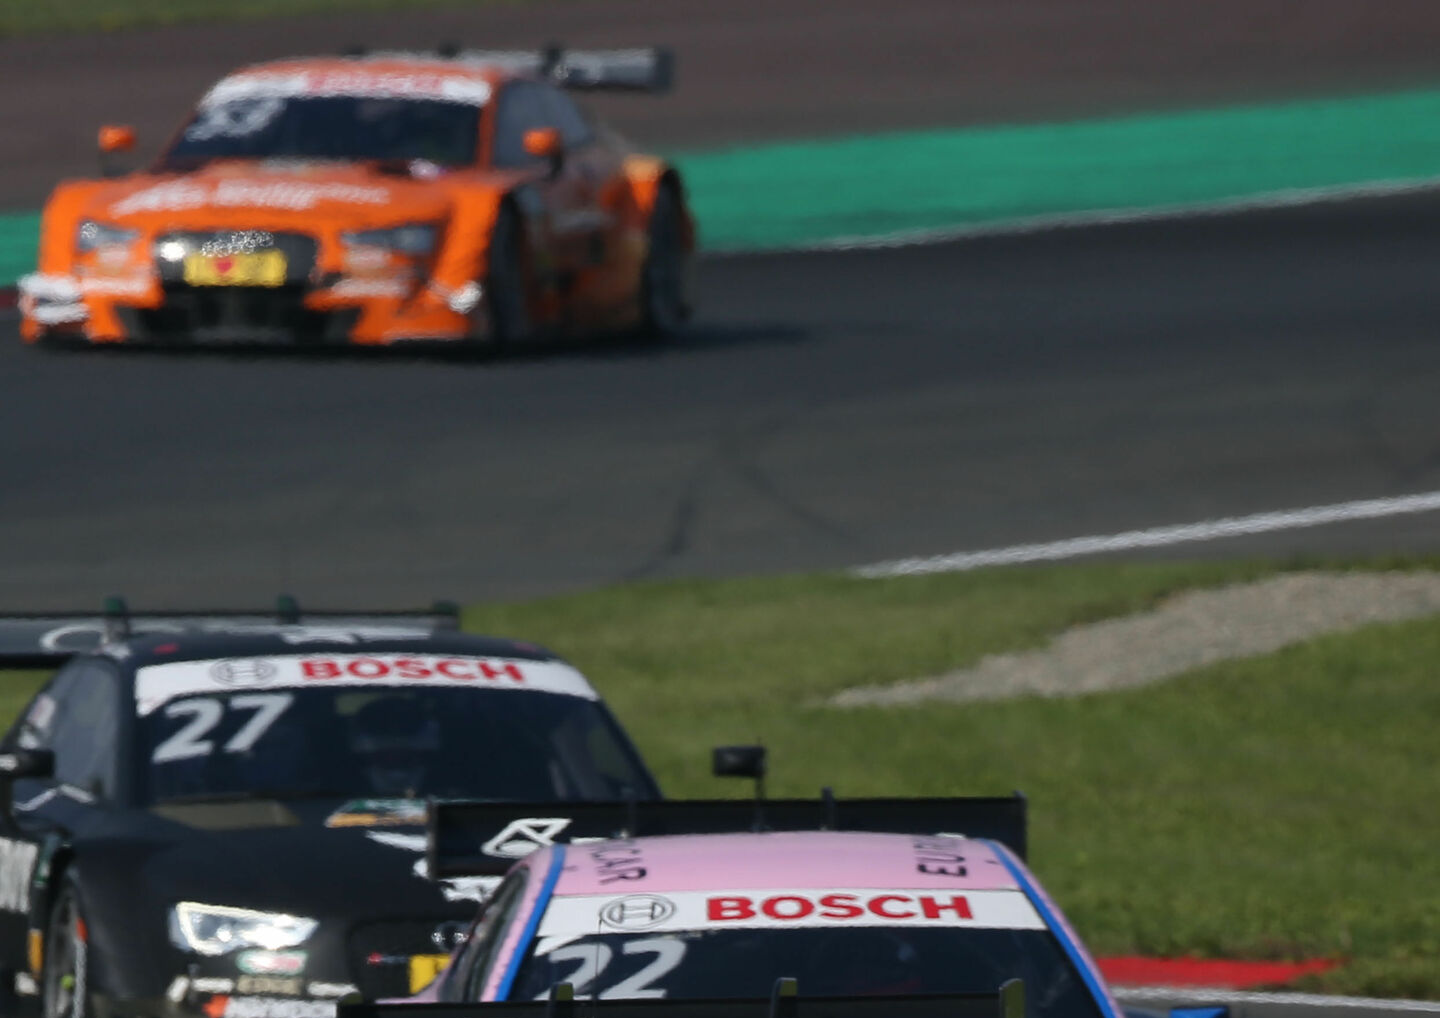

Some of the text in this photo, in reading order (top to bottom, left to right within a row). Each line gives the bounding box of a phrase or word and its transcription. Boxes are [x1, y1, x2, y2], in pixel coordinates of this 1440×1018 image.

[300, 658, 526, 684] BOSCH
[151, 693, 295, 765] 27
[706, 894, 974, 922] BOSCH
[535, 937, 687, 1001] 22
